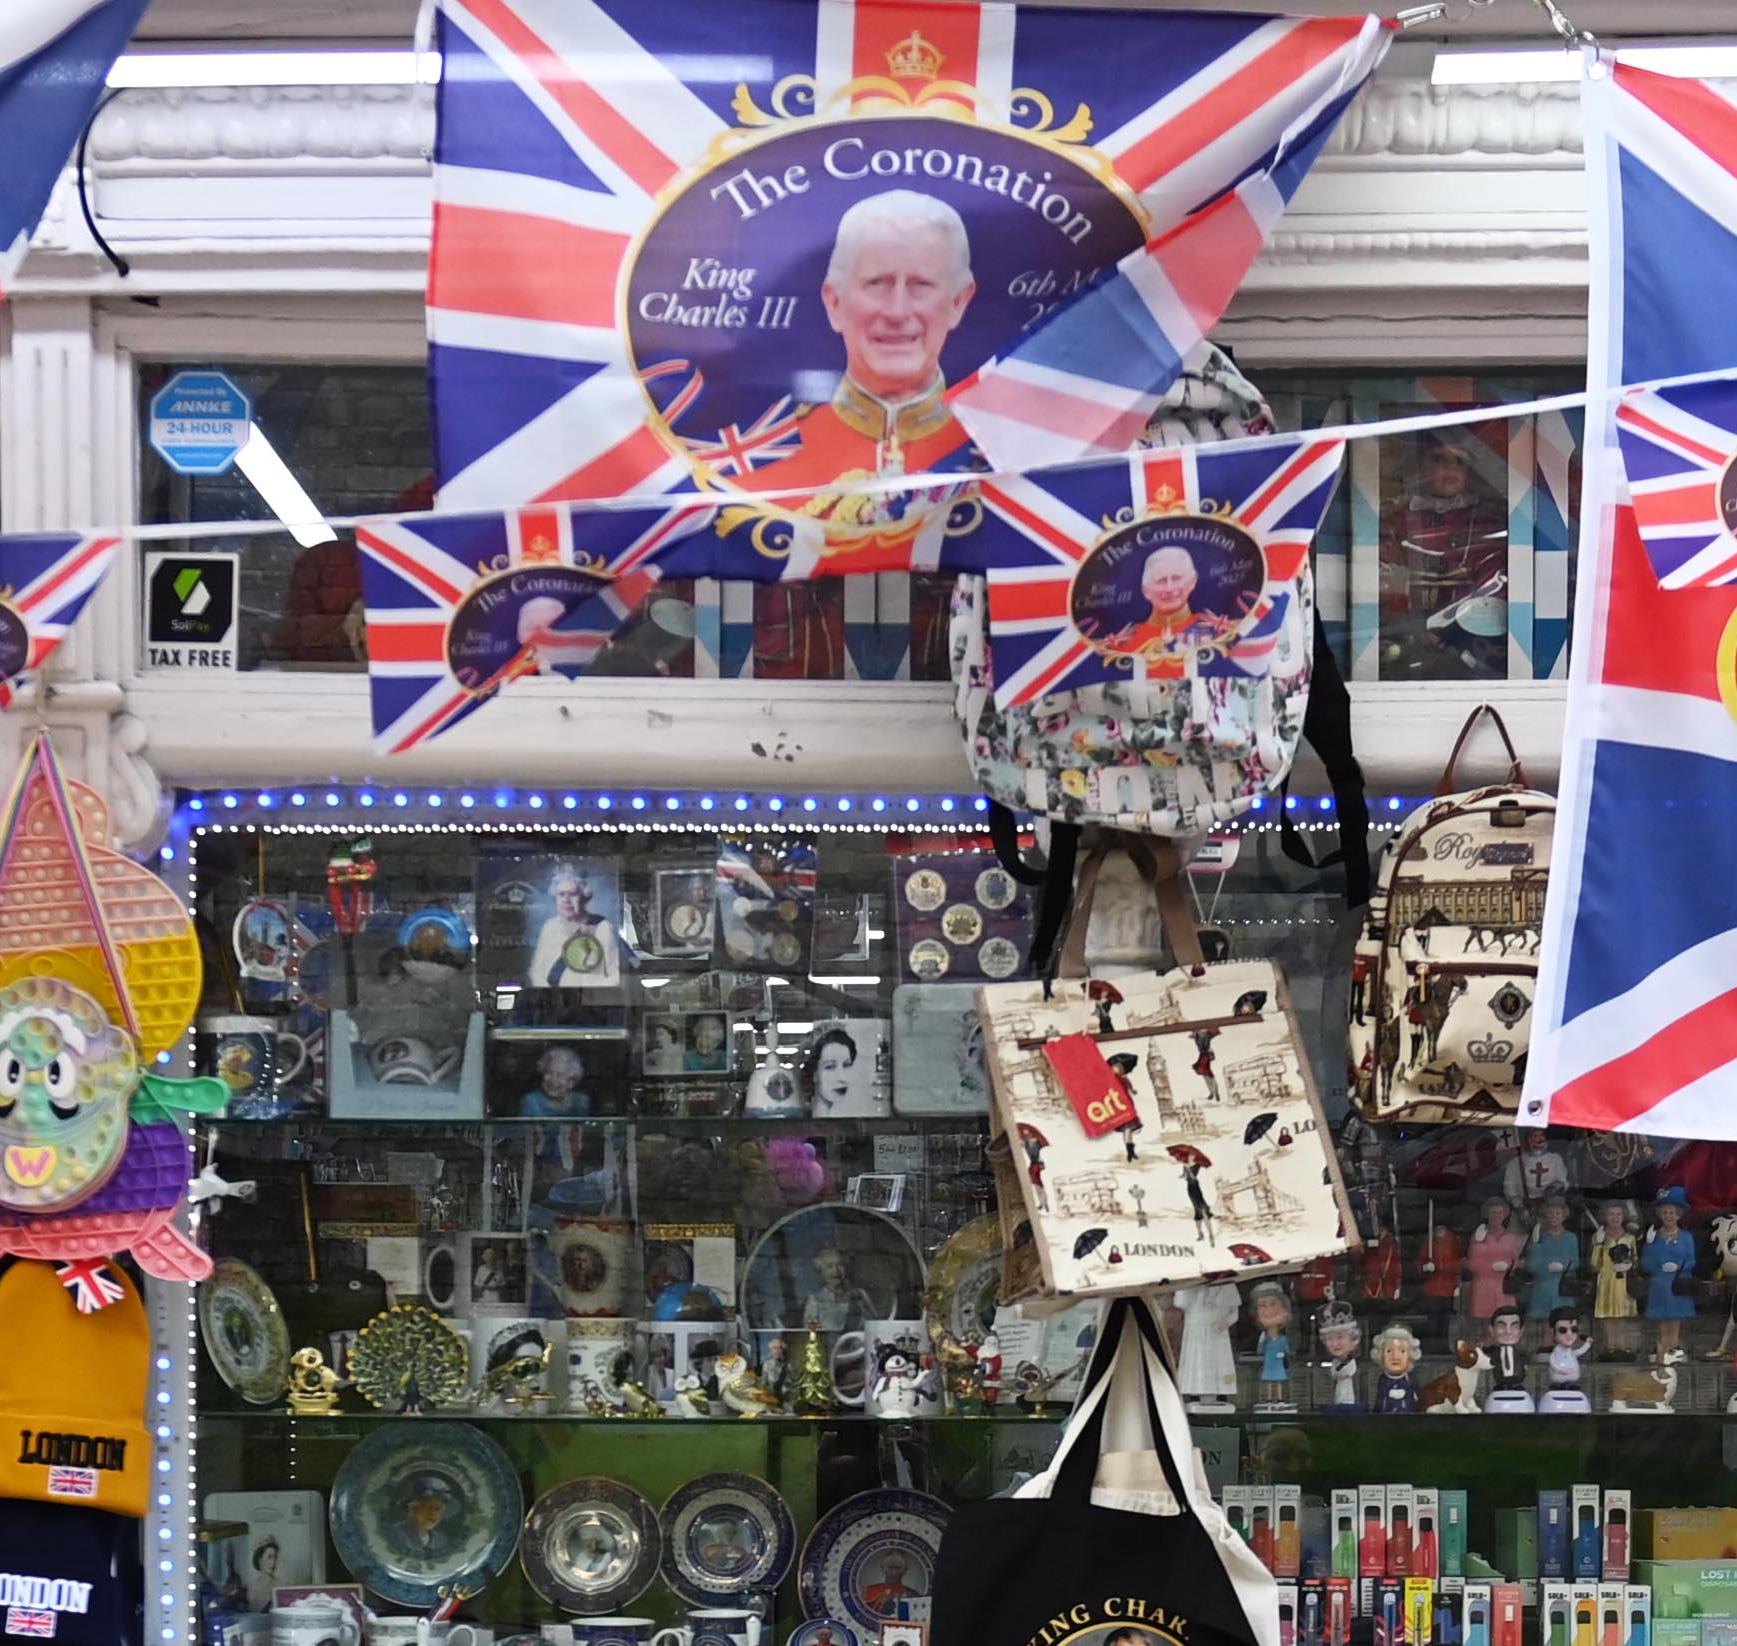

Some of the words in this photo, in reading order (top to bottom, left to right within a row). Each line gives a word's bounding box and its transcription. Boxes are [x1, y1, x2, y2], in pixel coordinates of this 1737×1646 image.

[710, 157, 812, 223] The
[821, 136, 1094, 247] Coronation
[681, 258, 755, 300] King
[1006, 267, 1062, 299] 6th
[638, 289, 750, 331] Charles
[755, 296, 798, 332] III
[169, 400, 232, 415] ANNKE
[1097, 540, 1133, 569] The
[1135, 523, 1238, 553] Coronation
[474, 588, 508, 614] The
[149, 649, 182, 667] TAX
[188, 649, 232, 668] FREE
[1086, 1087, 1127, 1124] art
[1123, 1242, 1195, 1258] LONDON
[17, 1428, 127, 1472] LONDON
[1700, 1569, 1732, 1580] LOST
